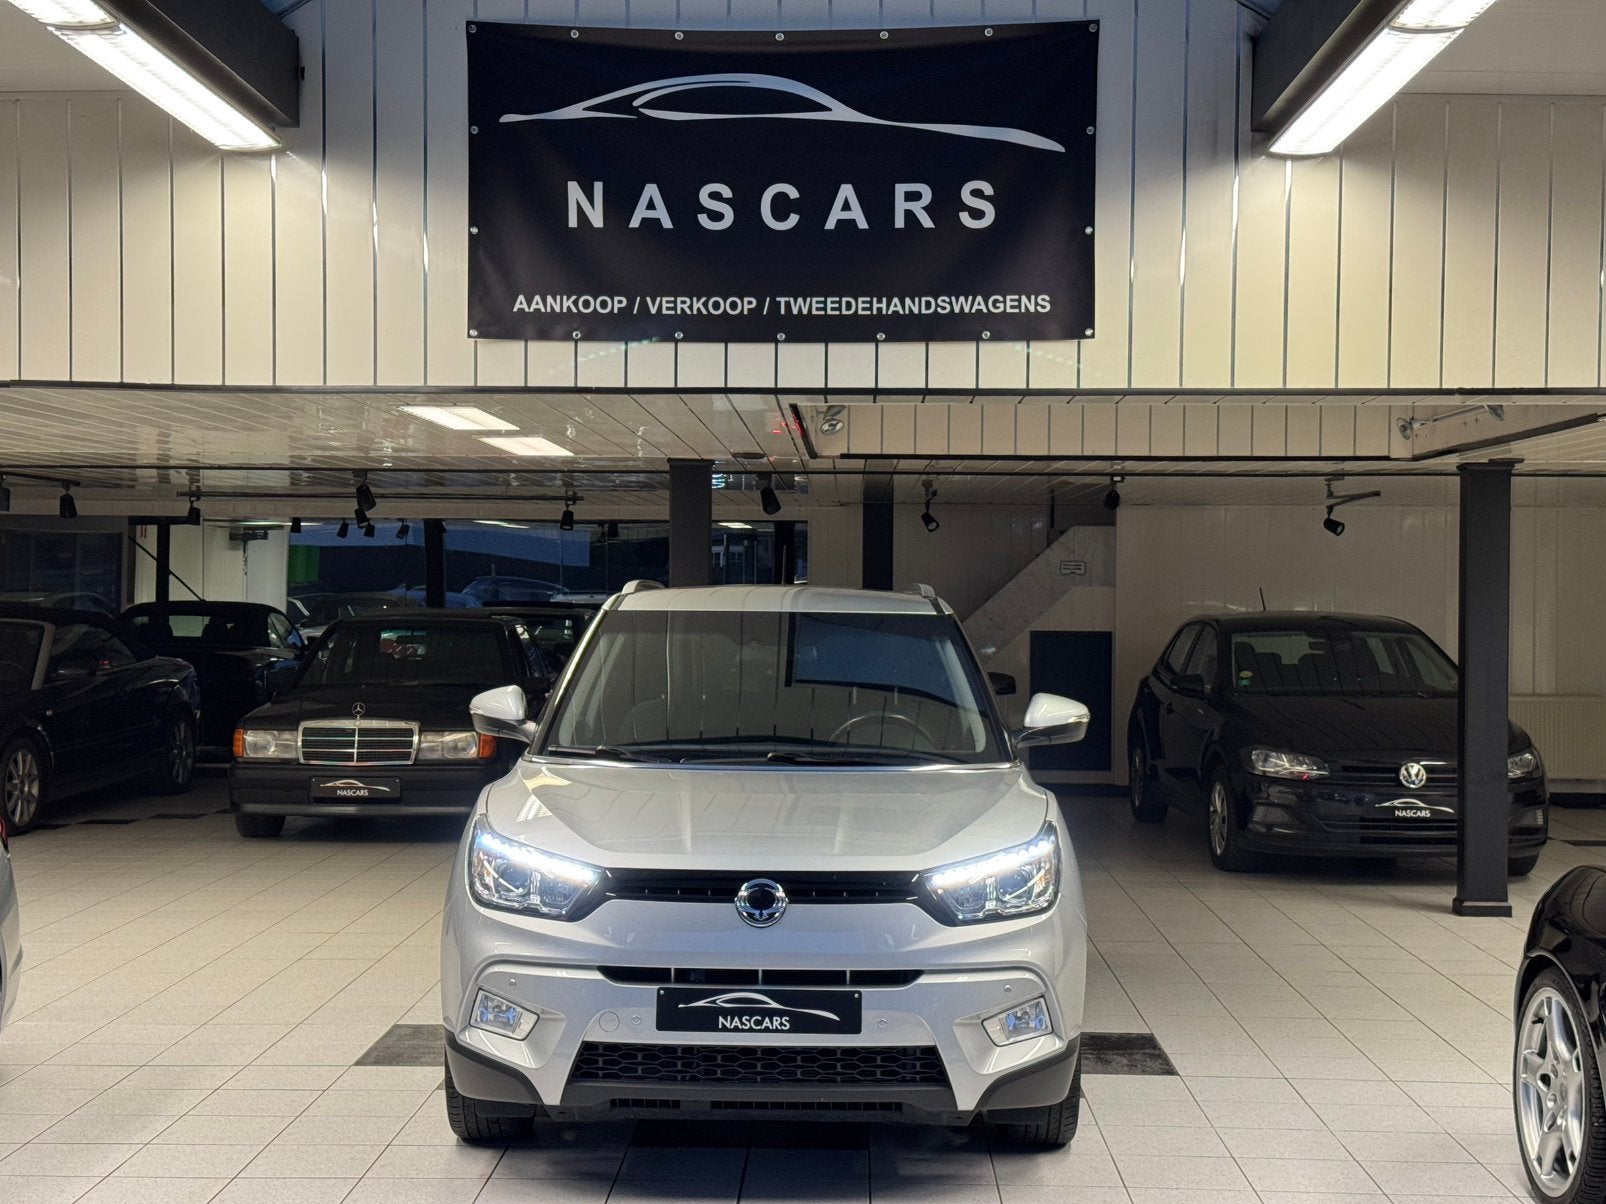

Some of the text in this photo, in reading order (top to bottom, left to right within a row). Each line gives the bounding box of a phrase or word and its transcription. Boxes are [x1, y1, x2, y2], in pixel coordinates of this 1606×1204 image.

[567, 180, 996, 231] NASCARS
[512, 294, 628, 314] AANKOOP
[645, 296, 757, 316] VERKOOP
[775, 294, 1051, 316] TWEEDEHANDSWAGENS
[1394, 809, 1431, 818] NASCARS
[718, 1015, 790, 1030] NASCARS
